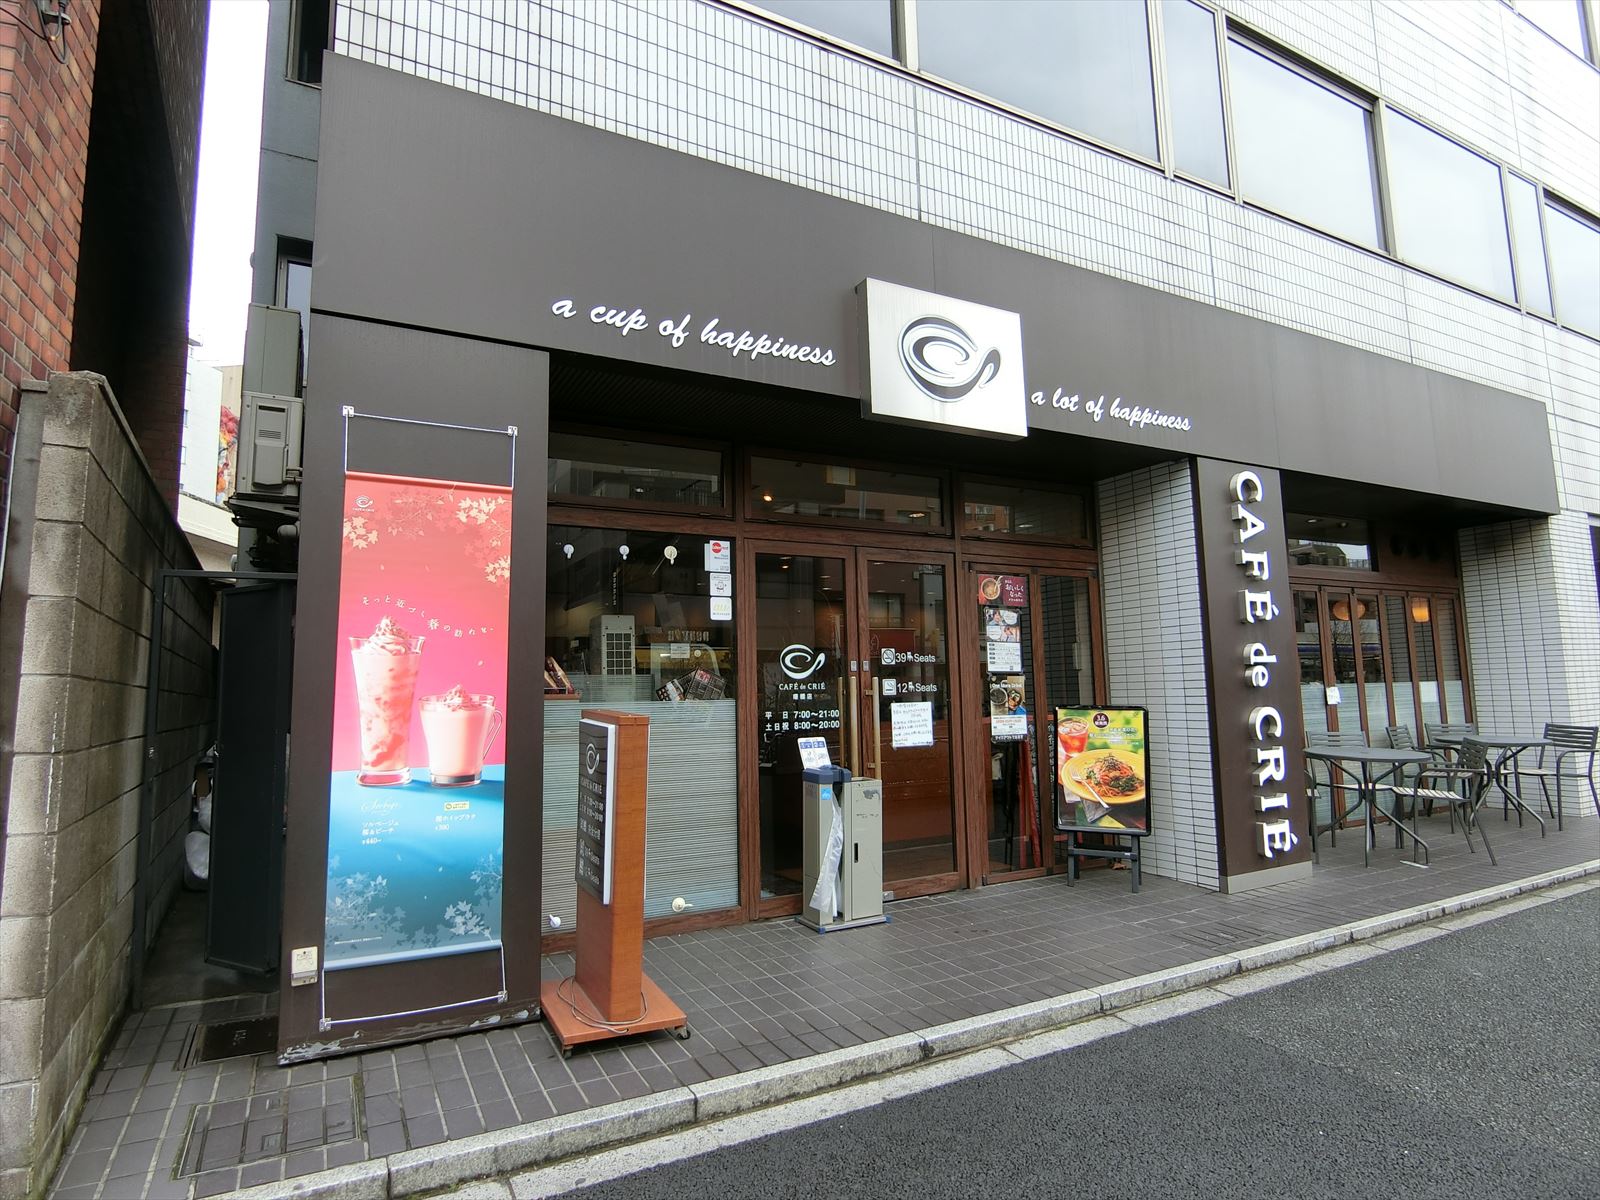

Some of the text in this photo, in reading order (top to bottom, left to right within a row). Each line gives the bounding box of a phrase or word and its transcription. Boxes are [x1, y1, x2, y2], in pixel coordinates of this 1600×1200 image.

[551, 299, 836, 366] a cup of happiness
[1030, 387, 1192, 431] a lot of happiness
[895, 652, 936, 663] 39 Seats
[1230, 471, 1297, 858] CAFÉ de CRIÉ
[778, 682, 799, 690] CAFÉ
[807, 681, 826, 690] CRIÉ
[897, 682, 938, 693] 12 Seats
[765, 721, 790, 731] 土日祝
